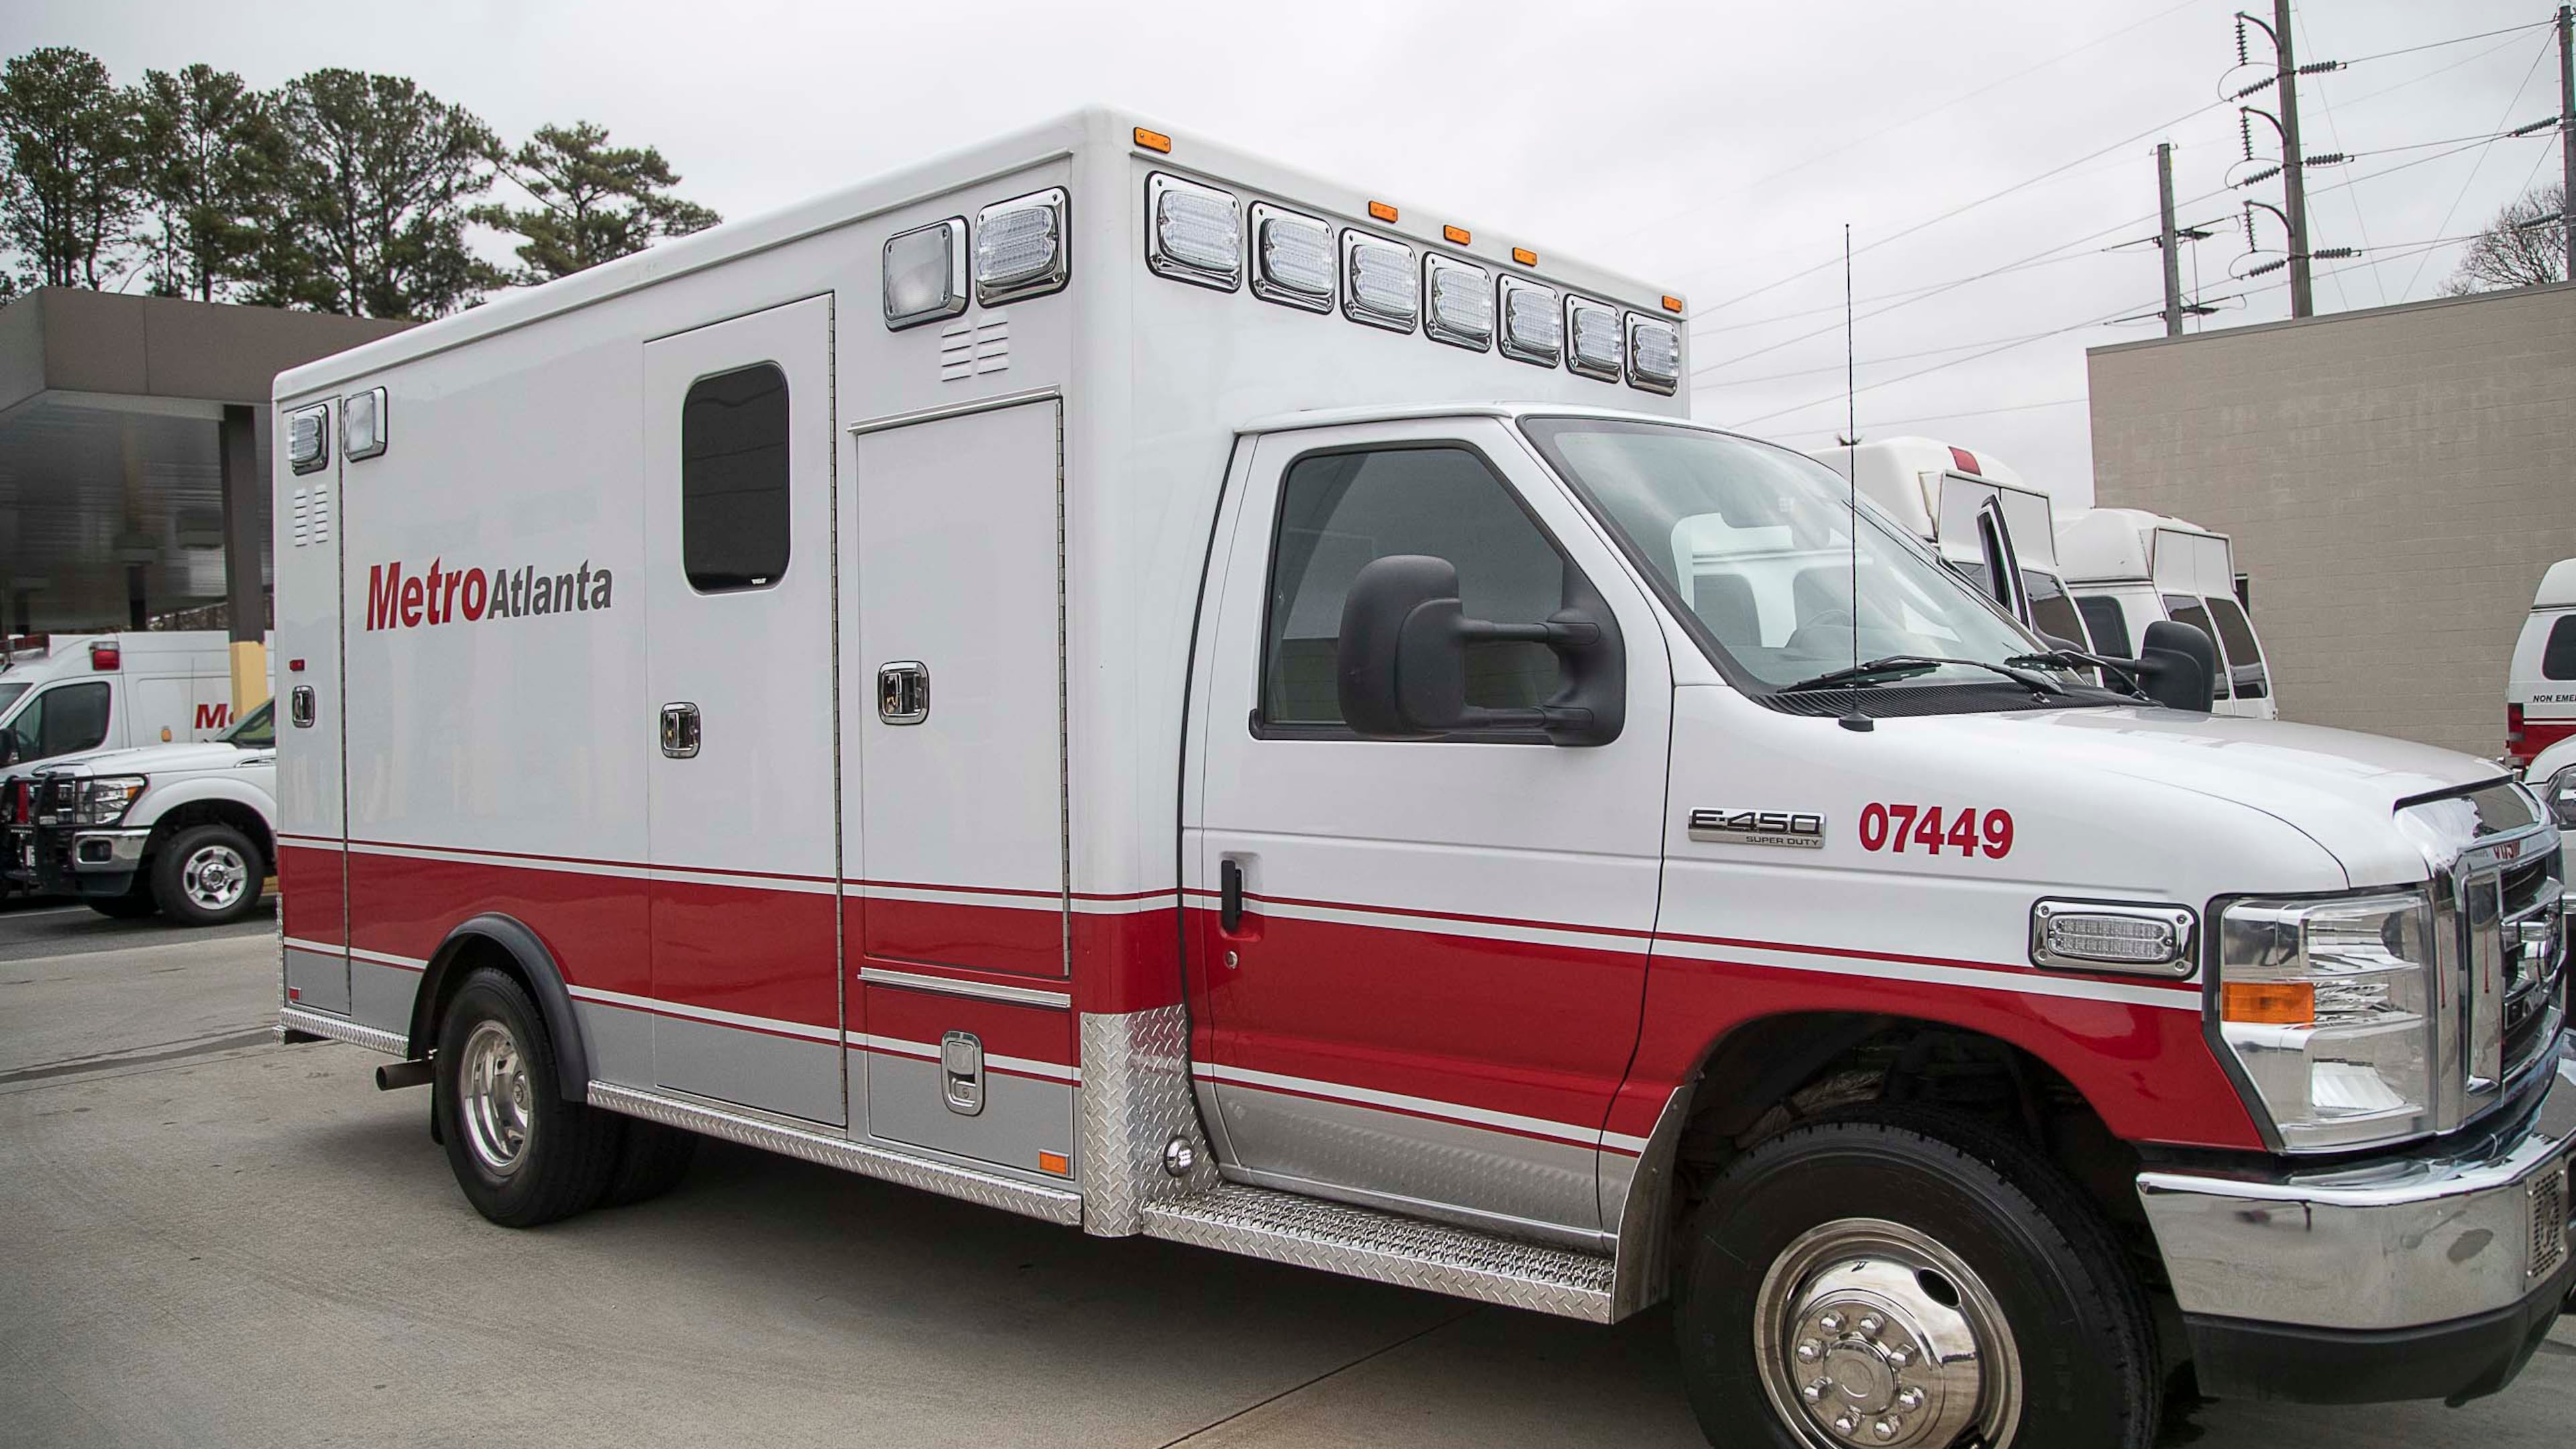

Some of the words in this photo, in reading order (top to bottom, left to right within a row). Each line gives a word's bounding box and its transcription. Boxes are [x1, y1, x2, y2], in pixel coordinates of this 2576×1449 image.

[2532, 694, 2553, 703] NON
[2555, 694, 2576, 703] EME
[1691, 809, 1821, 836] E-450
[1859, 802, 2014, 859] 07449
[1746, 835, 1784, 845] SUPER
[1786, 837, 1819, 846] DUTY
